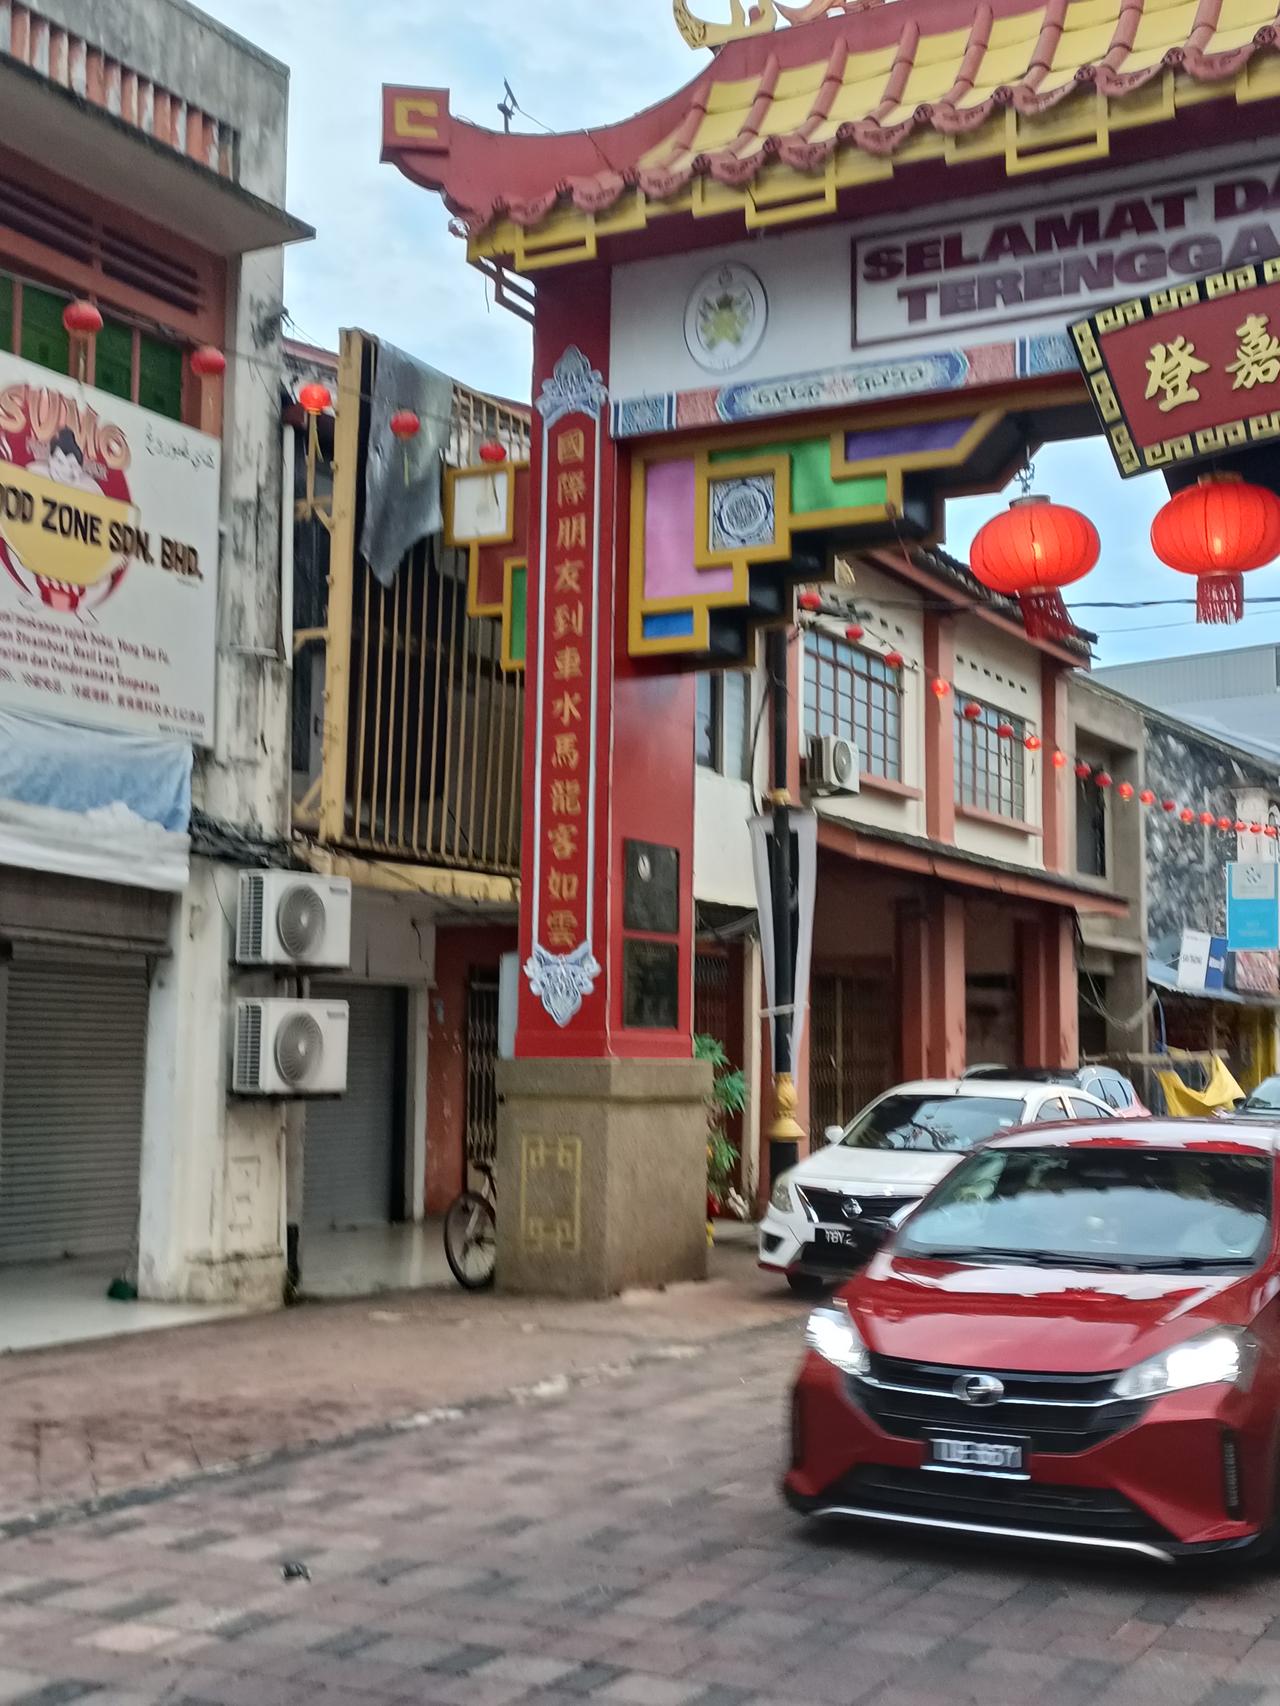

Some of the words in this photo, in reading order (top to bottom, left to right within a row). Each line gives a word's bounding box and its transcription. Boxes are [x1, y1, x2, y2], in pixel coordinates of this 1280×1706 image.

[863, 187, 1197, 282] SELAMAT
[1214, 173, 1280, 221] D
[41, 495, 103, 547] ZONE
[109, 520, 154, 565] SDN.
[160, 533, 204, 580] BHD.
